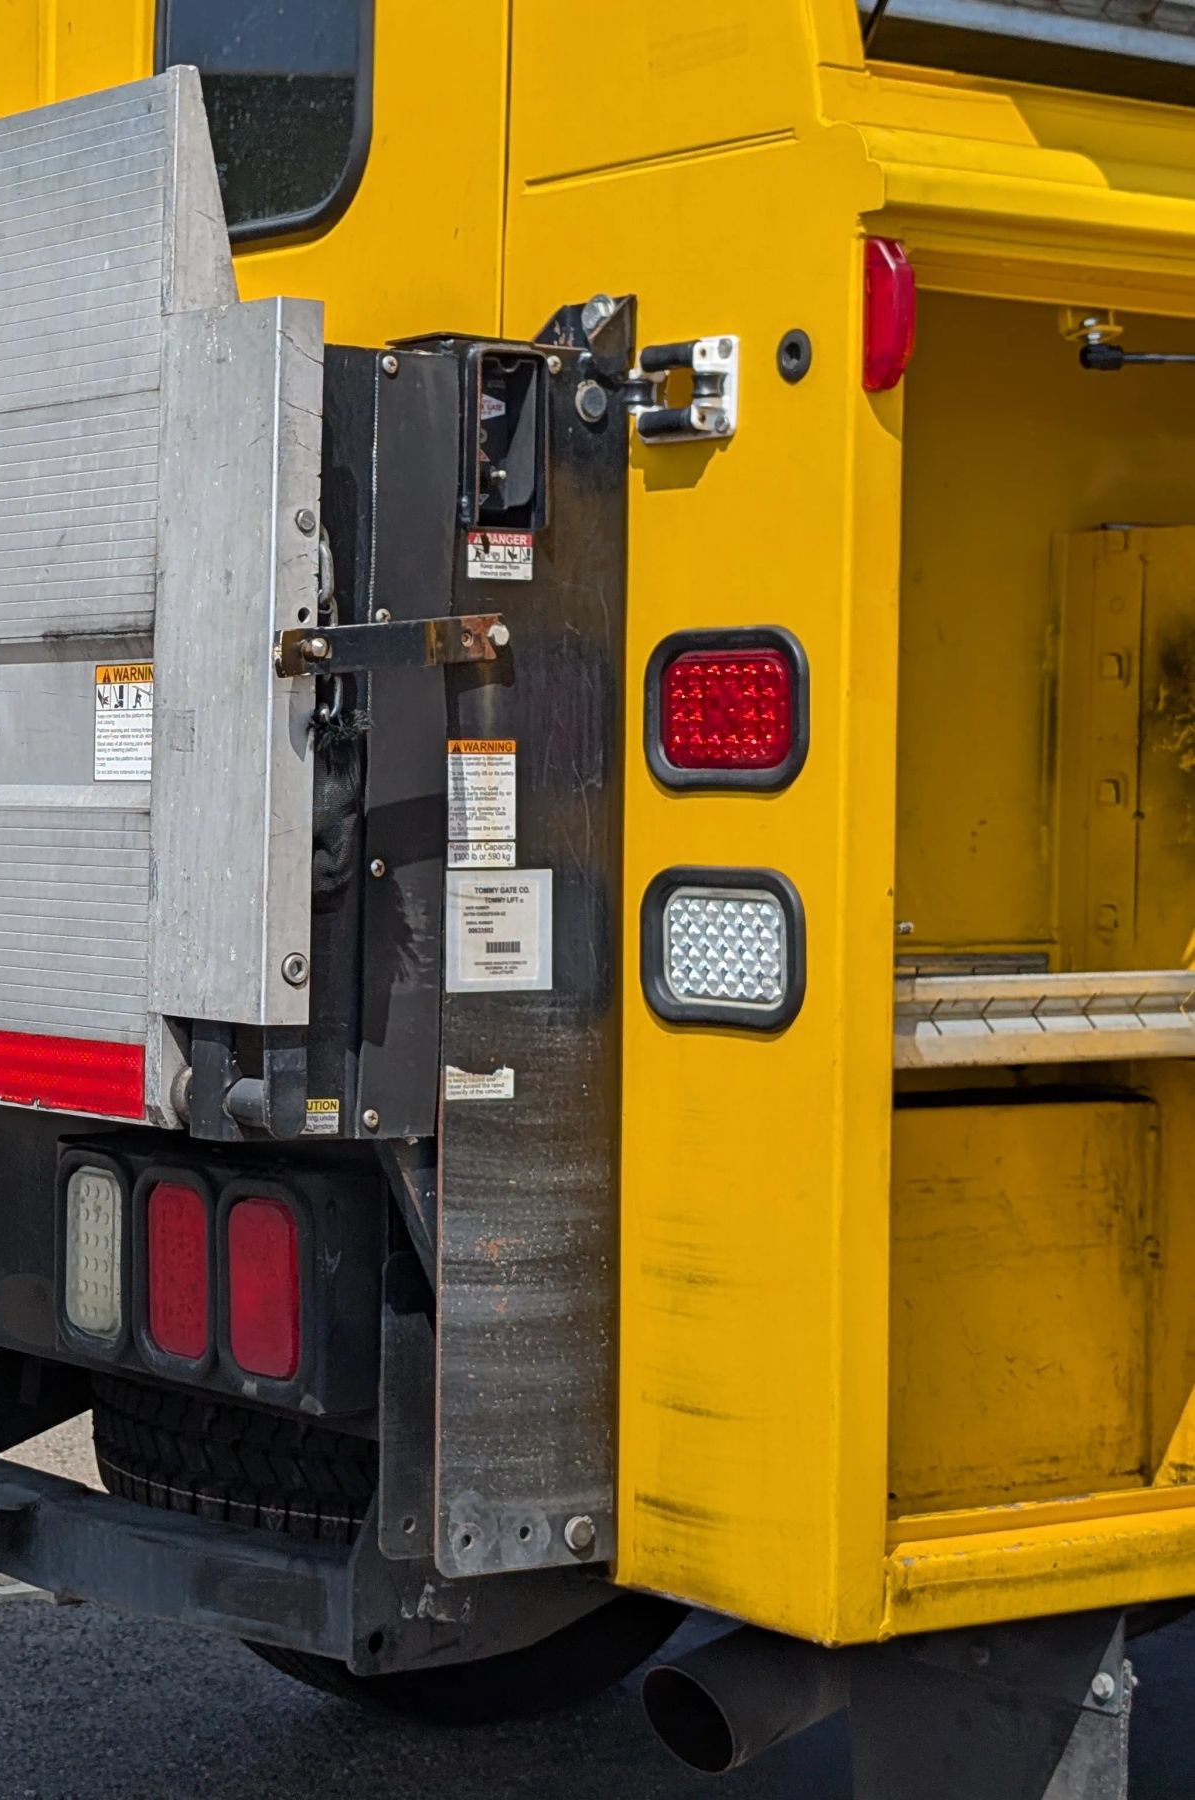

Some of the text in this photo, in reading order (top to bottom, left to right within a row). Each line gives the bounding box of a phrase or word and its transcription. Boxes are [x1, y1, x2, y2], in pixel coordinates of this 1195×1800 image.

[113, 665, 153, 681] WARNIN
[463, 742, 512, 752] WARNING
[484, 842, 512, 852] Capacity
[472, 852, 477, 860] lb
[502, 852, 510, 861] kg
[500, 886, 517, 894] GATE
[307, 1101, 337, 1111] UTION
